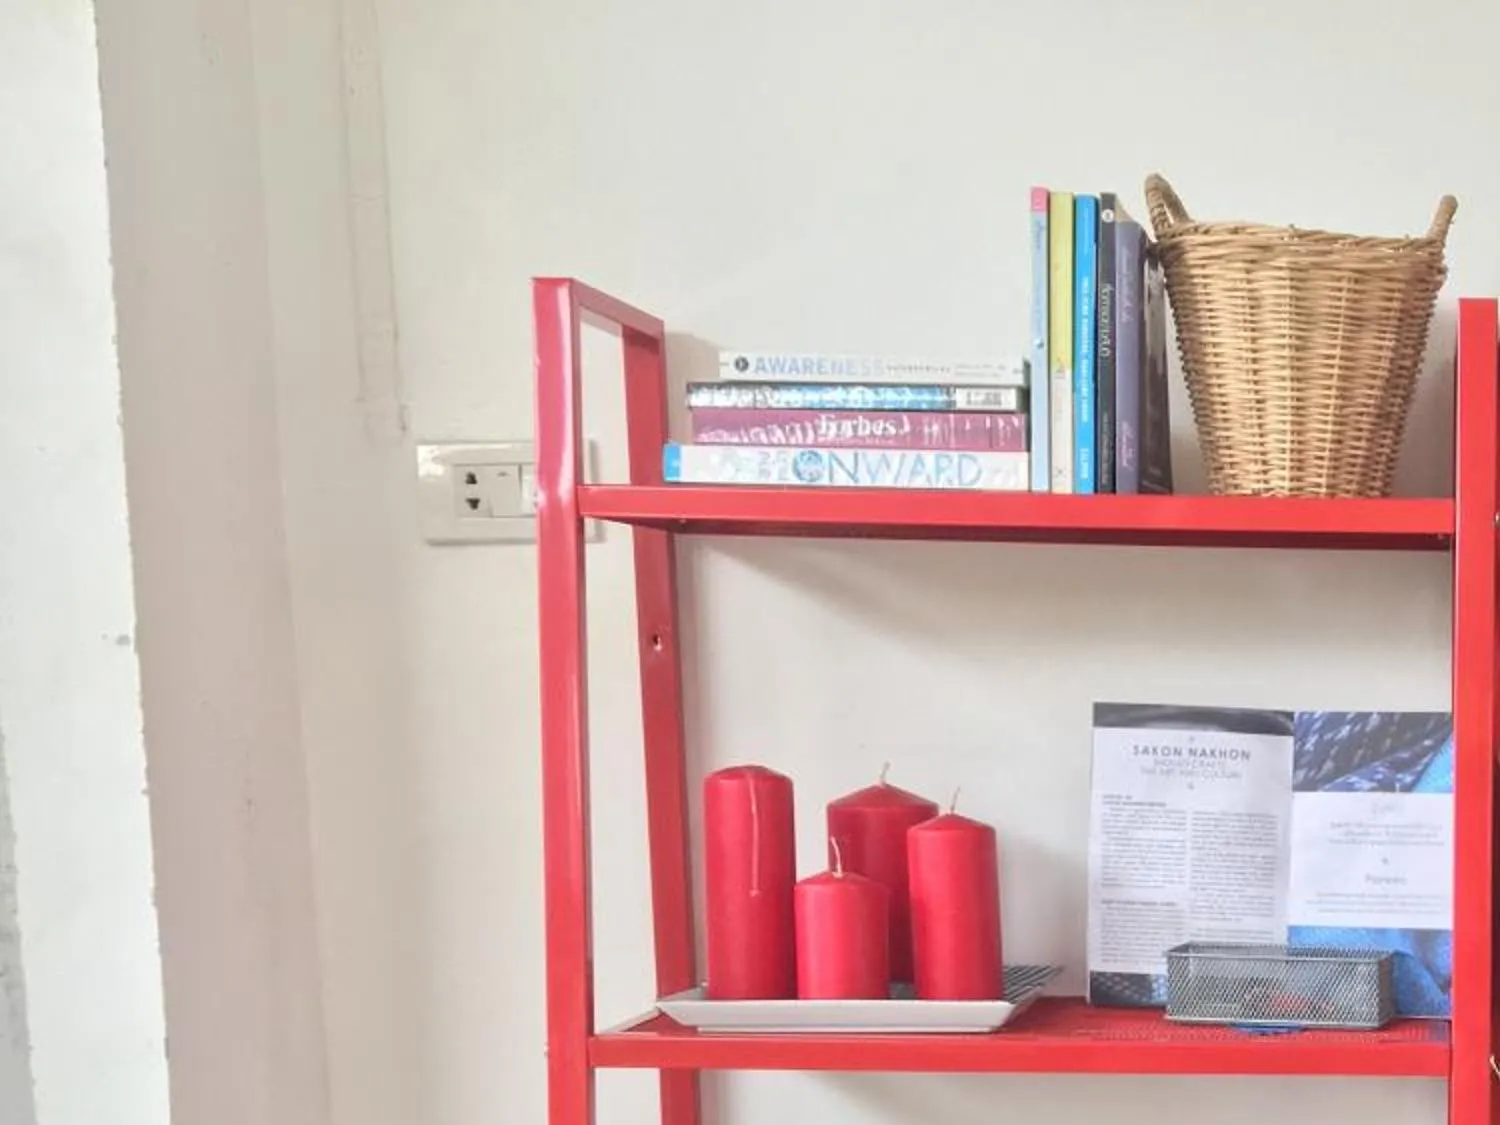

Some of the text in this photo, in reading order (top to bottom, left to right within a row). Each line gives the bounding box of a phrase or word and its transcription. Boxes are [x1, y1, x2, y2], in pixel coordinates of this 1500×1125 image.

[753, 356, 887, 376] AWARENESS
[820, 412, 897, 439] Forbes
[793, 449, 983, 487] ONWARD
[1132, 744, 1251, 761] SAKON NAKHON
